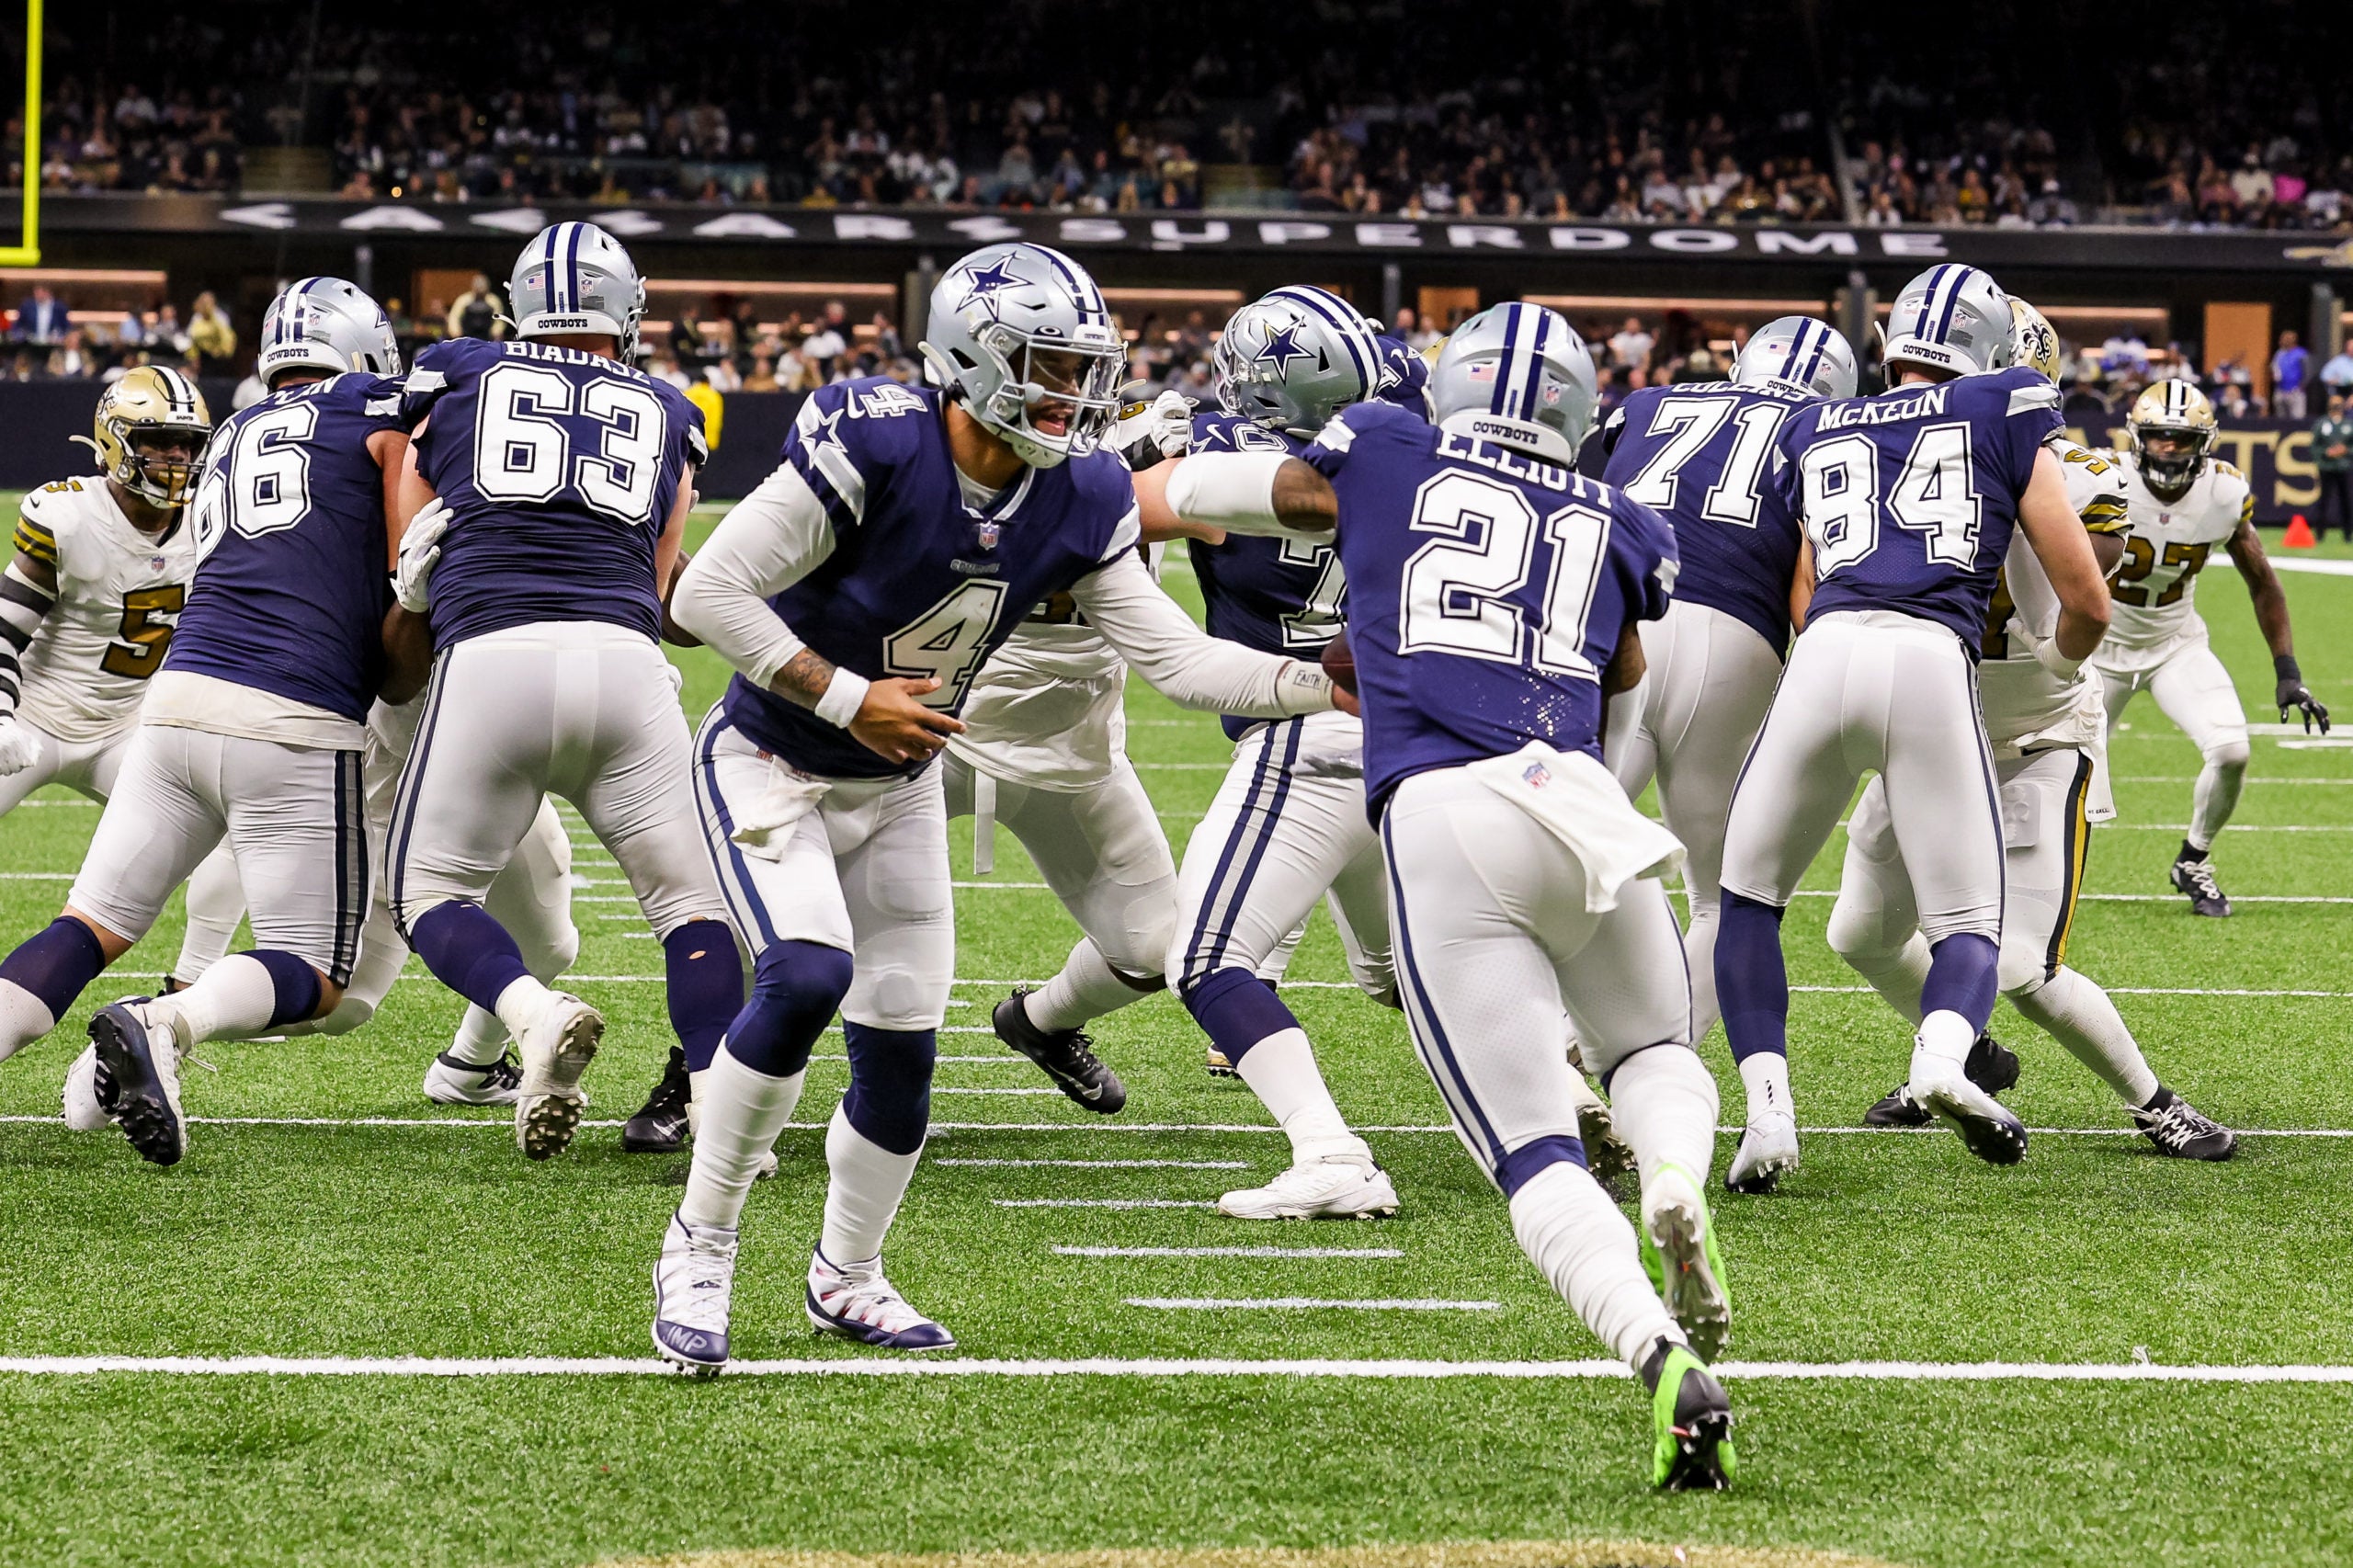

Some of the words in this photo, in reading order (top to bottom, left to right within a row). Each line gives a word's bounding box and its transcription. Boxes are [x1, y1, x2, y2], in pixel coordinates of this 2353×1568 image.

[1059, 217, 1949, 257] SUPERDOME
[538, 319, 587, 328] COWBOYS
[267, 348, 309, 362] COWBOYS
[1903, 345, 1950, 363] COWBOYS
[1472, 421, 1539, 445] COWBOYS
[1815, 386, 1949, 433] McKEON
[472, 361, 667, 526] 63
[1620, 396, 1791, 529] 71
[191, 400, 320, 570] 66
[1800, 420, 1983, 581] 84
[1398, 467, 1612, 686] 21
[2106, 535, 2213, 608] 27
[99, 583, 185, 680] 5
[882, 577, 1009, 714] 4
[1293, 669, 1322, 689] FAITH
[662, 1324, 708, 1353] JMP
